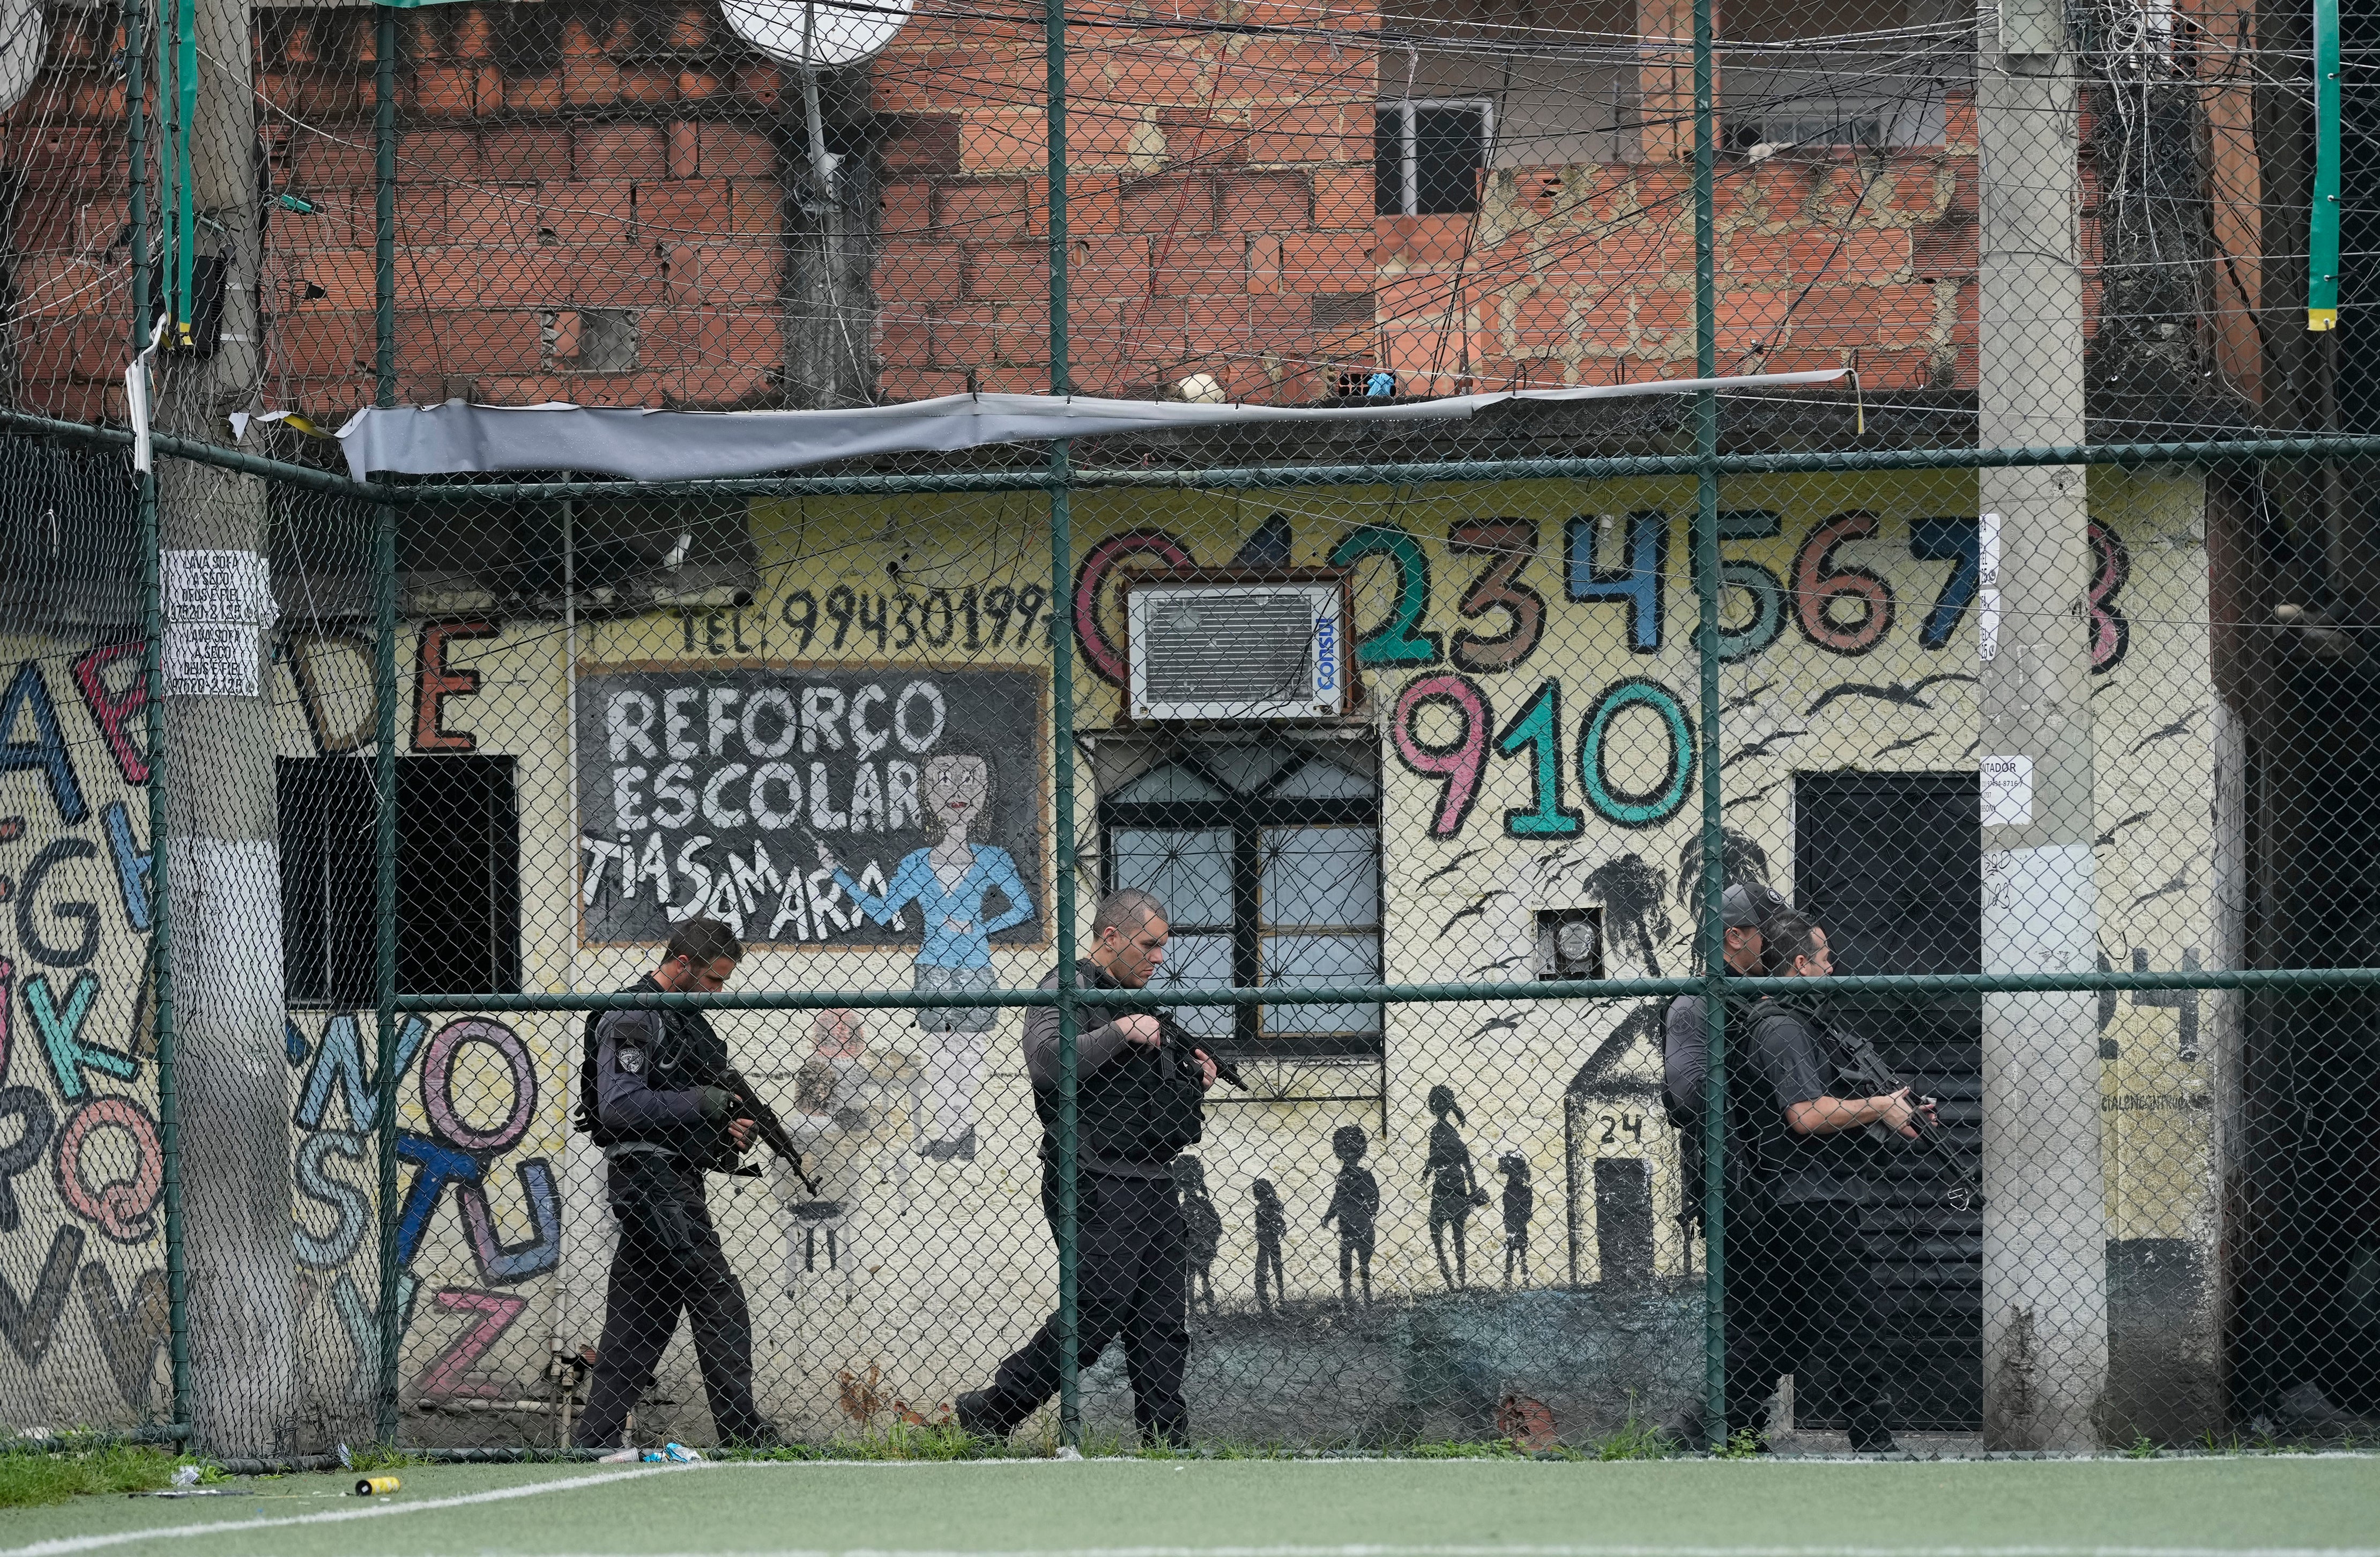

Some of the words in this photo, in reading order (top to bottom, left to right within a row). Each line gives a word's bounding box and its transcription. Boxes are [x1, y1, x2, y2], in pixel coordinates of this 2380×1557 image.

[182, 589, 207, 602] DEUS
[220, 589, 241, 602] FIEL
[185, 556, 209, 569] LAVA
[212, 554, 239, 569] SOFÁ
[193, 573, 199, 585] A
[203, 573, 229, 585] SECO
[1327, 522, 1442, 669] 2
[1448, 517, 1548, 674] 3
[1564, 510, 1670, 654] 4
[1689, 509, 1787, 665] 5
[1790, 509, 1895, 657] 6
[1909, 517, 1980, 650] 7
[184, 662, 209, 675] DEUS
[212, 659, 218, 675] É
[221, 662, 242, 675] FIEL
[187, 629, 211, 643] LAVA
[214, 628, 240, 643] SOFÁ
[195, 646, 201, 658] A
[204, 646, 231, 658] SECO
[0, 659, 90, 826] A
[410, 617, 503, 753] E
[607, 679, 947, 763] REFORÇO
[612, 761, 923, 833] ESCOLAR
[16, 838, 101, 968] G
[20, 968, 143, 1104] K
[420, 1015, 538, 1156] O
[1600, 1113, 1642, 1145] 24
[53, 1093, 166, 1245] Q
[292, 1128, 371, 1273] S
[395, 1128, 492, 1267] T
[456, 1156, 561, 1286] U
[410, 1287, 528, 1397] Z
